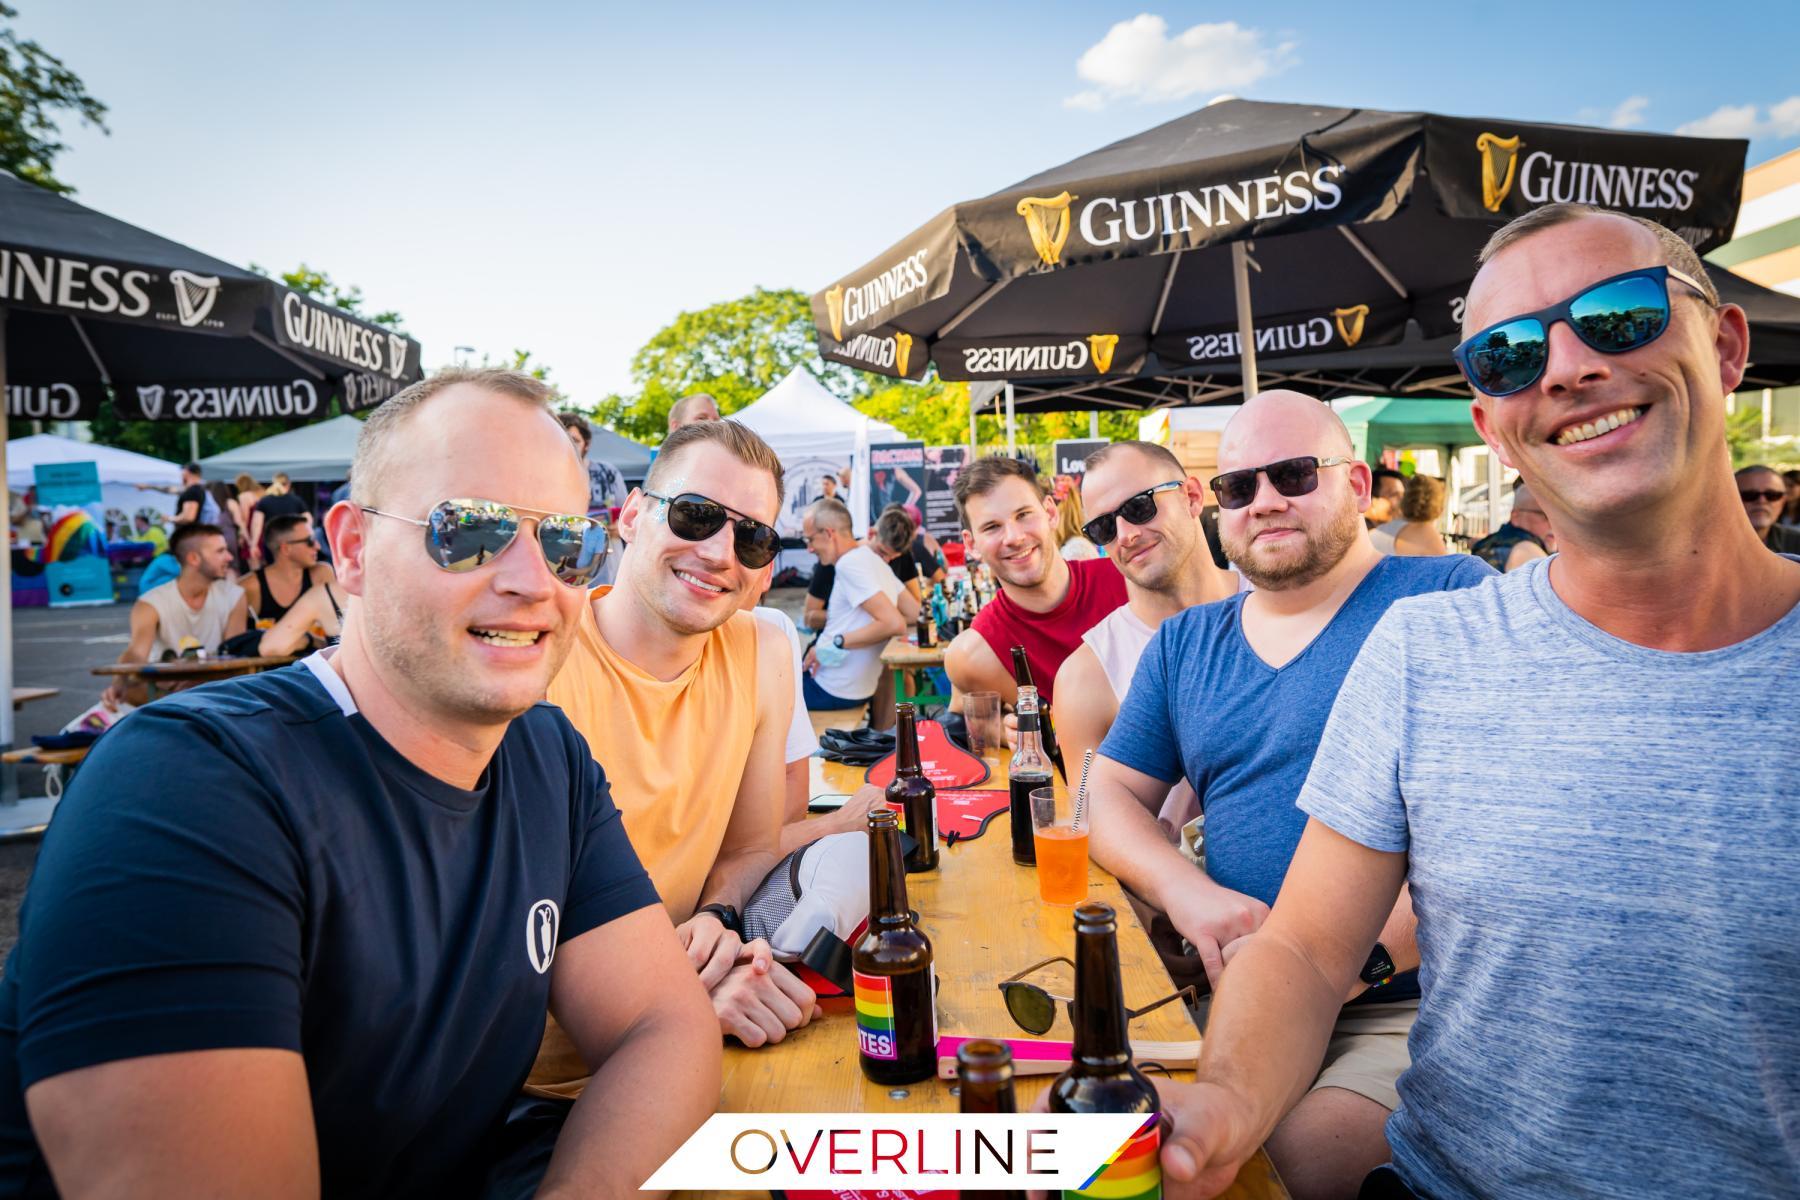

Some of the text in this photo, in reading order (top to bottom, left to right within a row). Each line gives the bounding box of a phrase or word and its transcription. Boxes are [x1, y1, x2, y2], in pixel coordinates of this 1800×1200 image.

[1079, 164, 1345, 247] GUINNESS
[1520, 151, 1697, 211] GUINNESS
[0, 249, 151, 317] NESS
[843, 248, 929, 327] GUINNESS
[284, 292, 383, 371] GUINNESS
